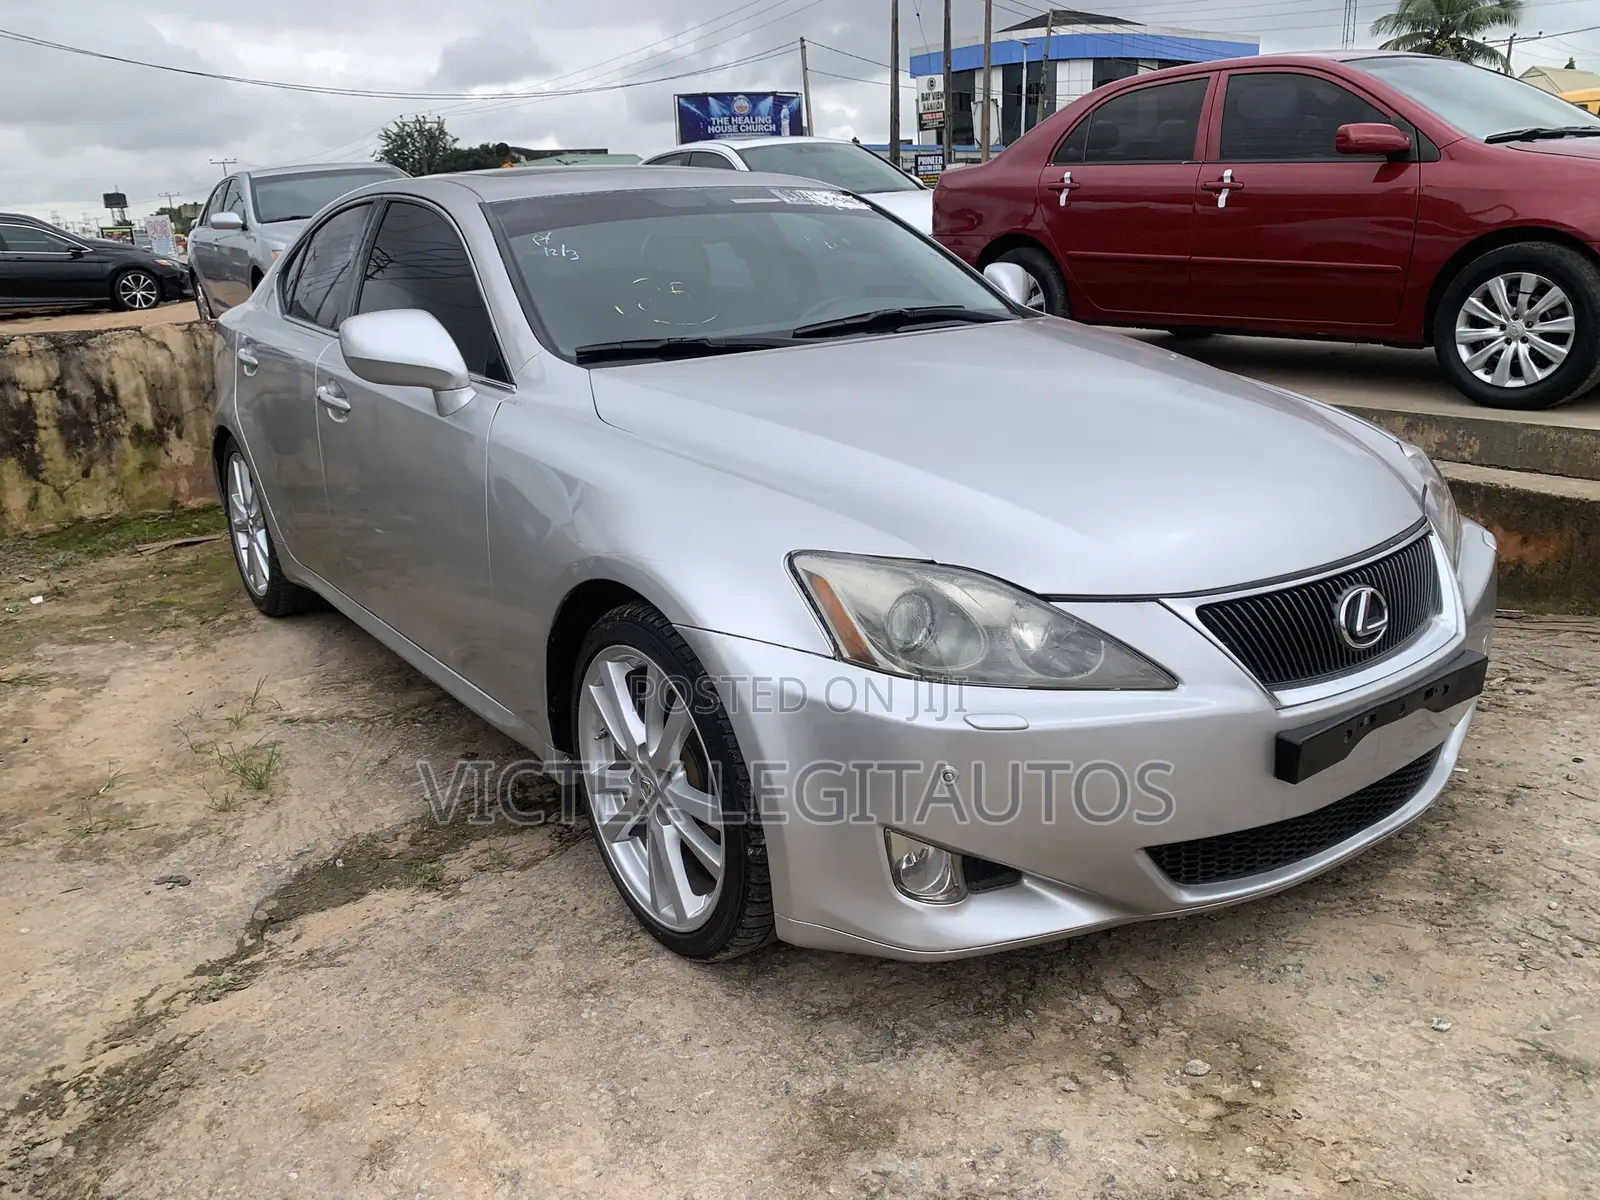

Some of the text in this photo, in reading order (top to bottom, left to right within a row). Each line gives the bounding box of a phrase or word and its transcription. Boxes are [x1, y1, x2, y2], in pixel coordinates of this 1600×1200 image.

[711, 116, 772, 125] THE HEALING
[708, 124, 776, 134] HOUSE CHURCH
[918, 155, 943, 165] PIONEER
